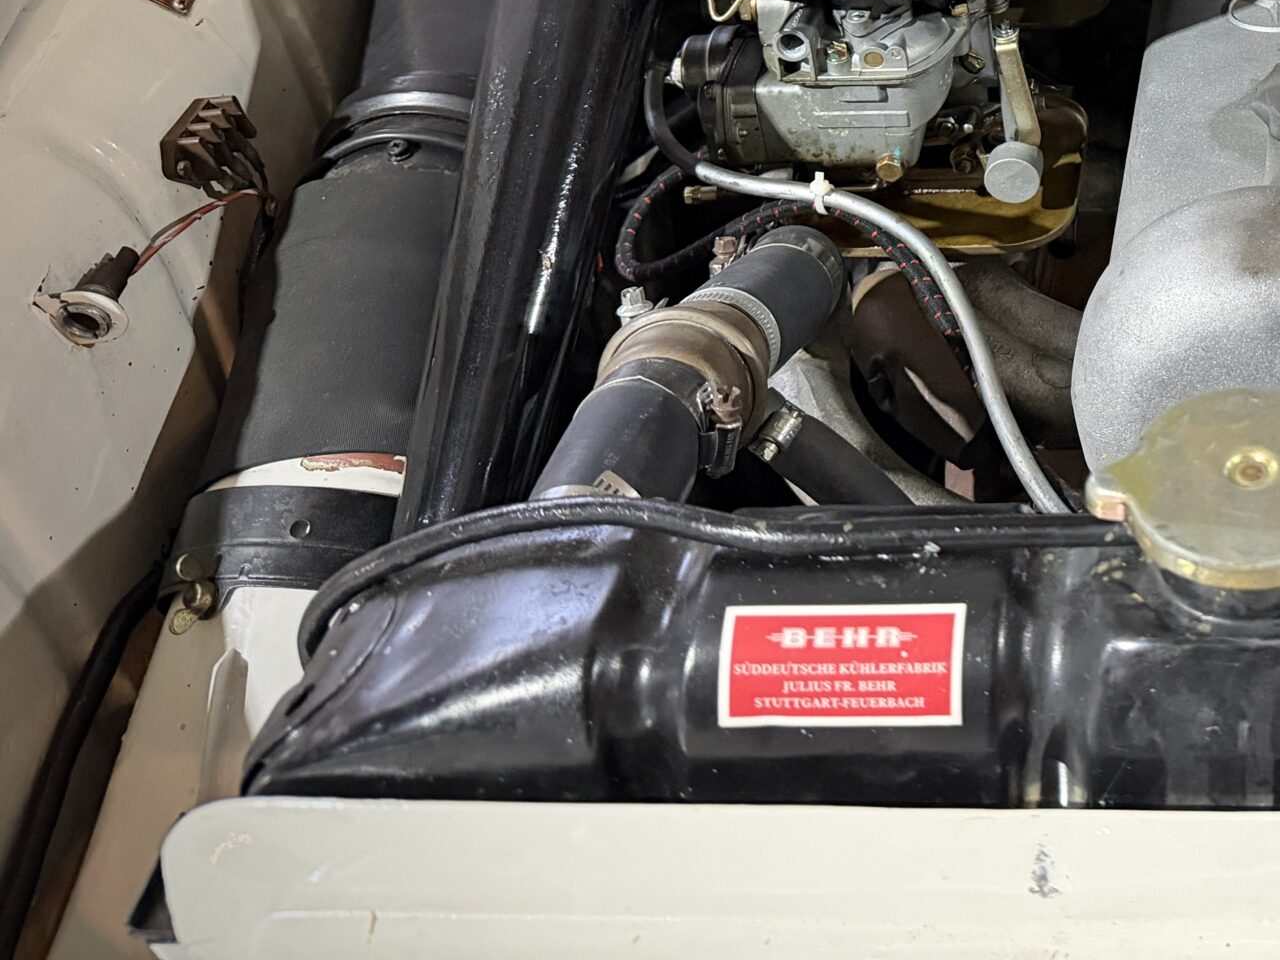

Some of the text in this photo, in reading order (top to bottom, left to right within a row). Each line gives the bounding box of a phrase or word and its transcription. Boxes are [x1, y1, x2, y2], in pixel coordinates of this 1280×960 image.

[780, 626, 902, 649] BEHR
[733, 660, 947, 676] SÜDDEUTSCHE KÜHLERFABRIK
[782, 680, 897, 694] JULIUS FR. BEHR
[754, 697, 925, 709] STUTTGART-FEUERBACH
